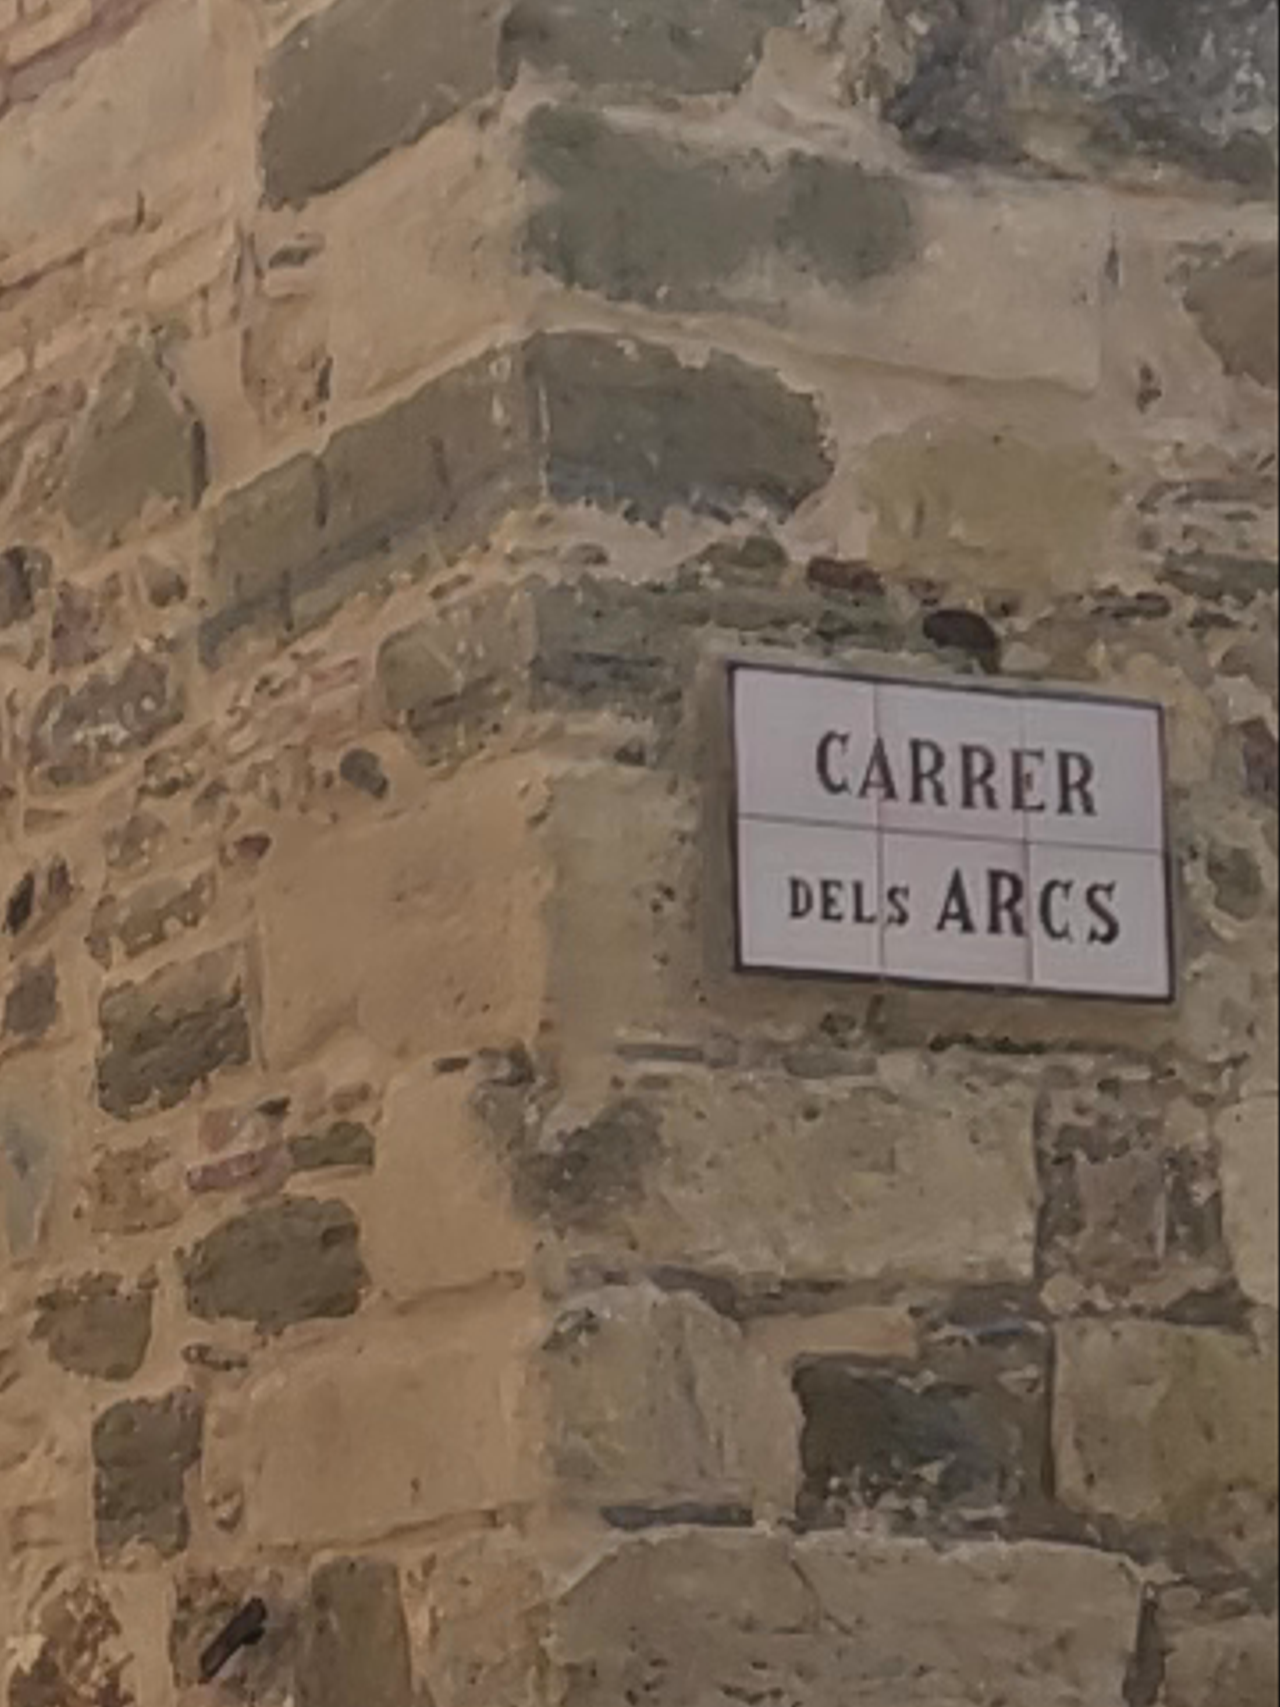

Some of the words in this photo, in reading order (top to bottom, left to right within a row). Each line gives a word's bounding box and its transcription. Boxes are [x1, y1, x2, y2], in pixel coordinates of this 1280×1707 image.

[815, 730, 1097, 817] CARRER
[789, 876, 911, 927] DELS
[936, 868, 1121, 944] ARCS
